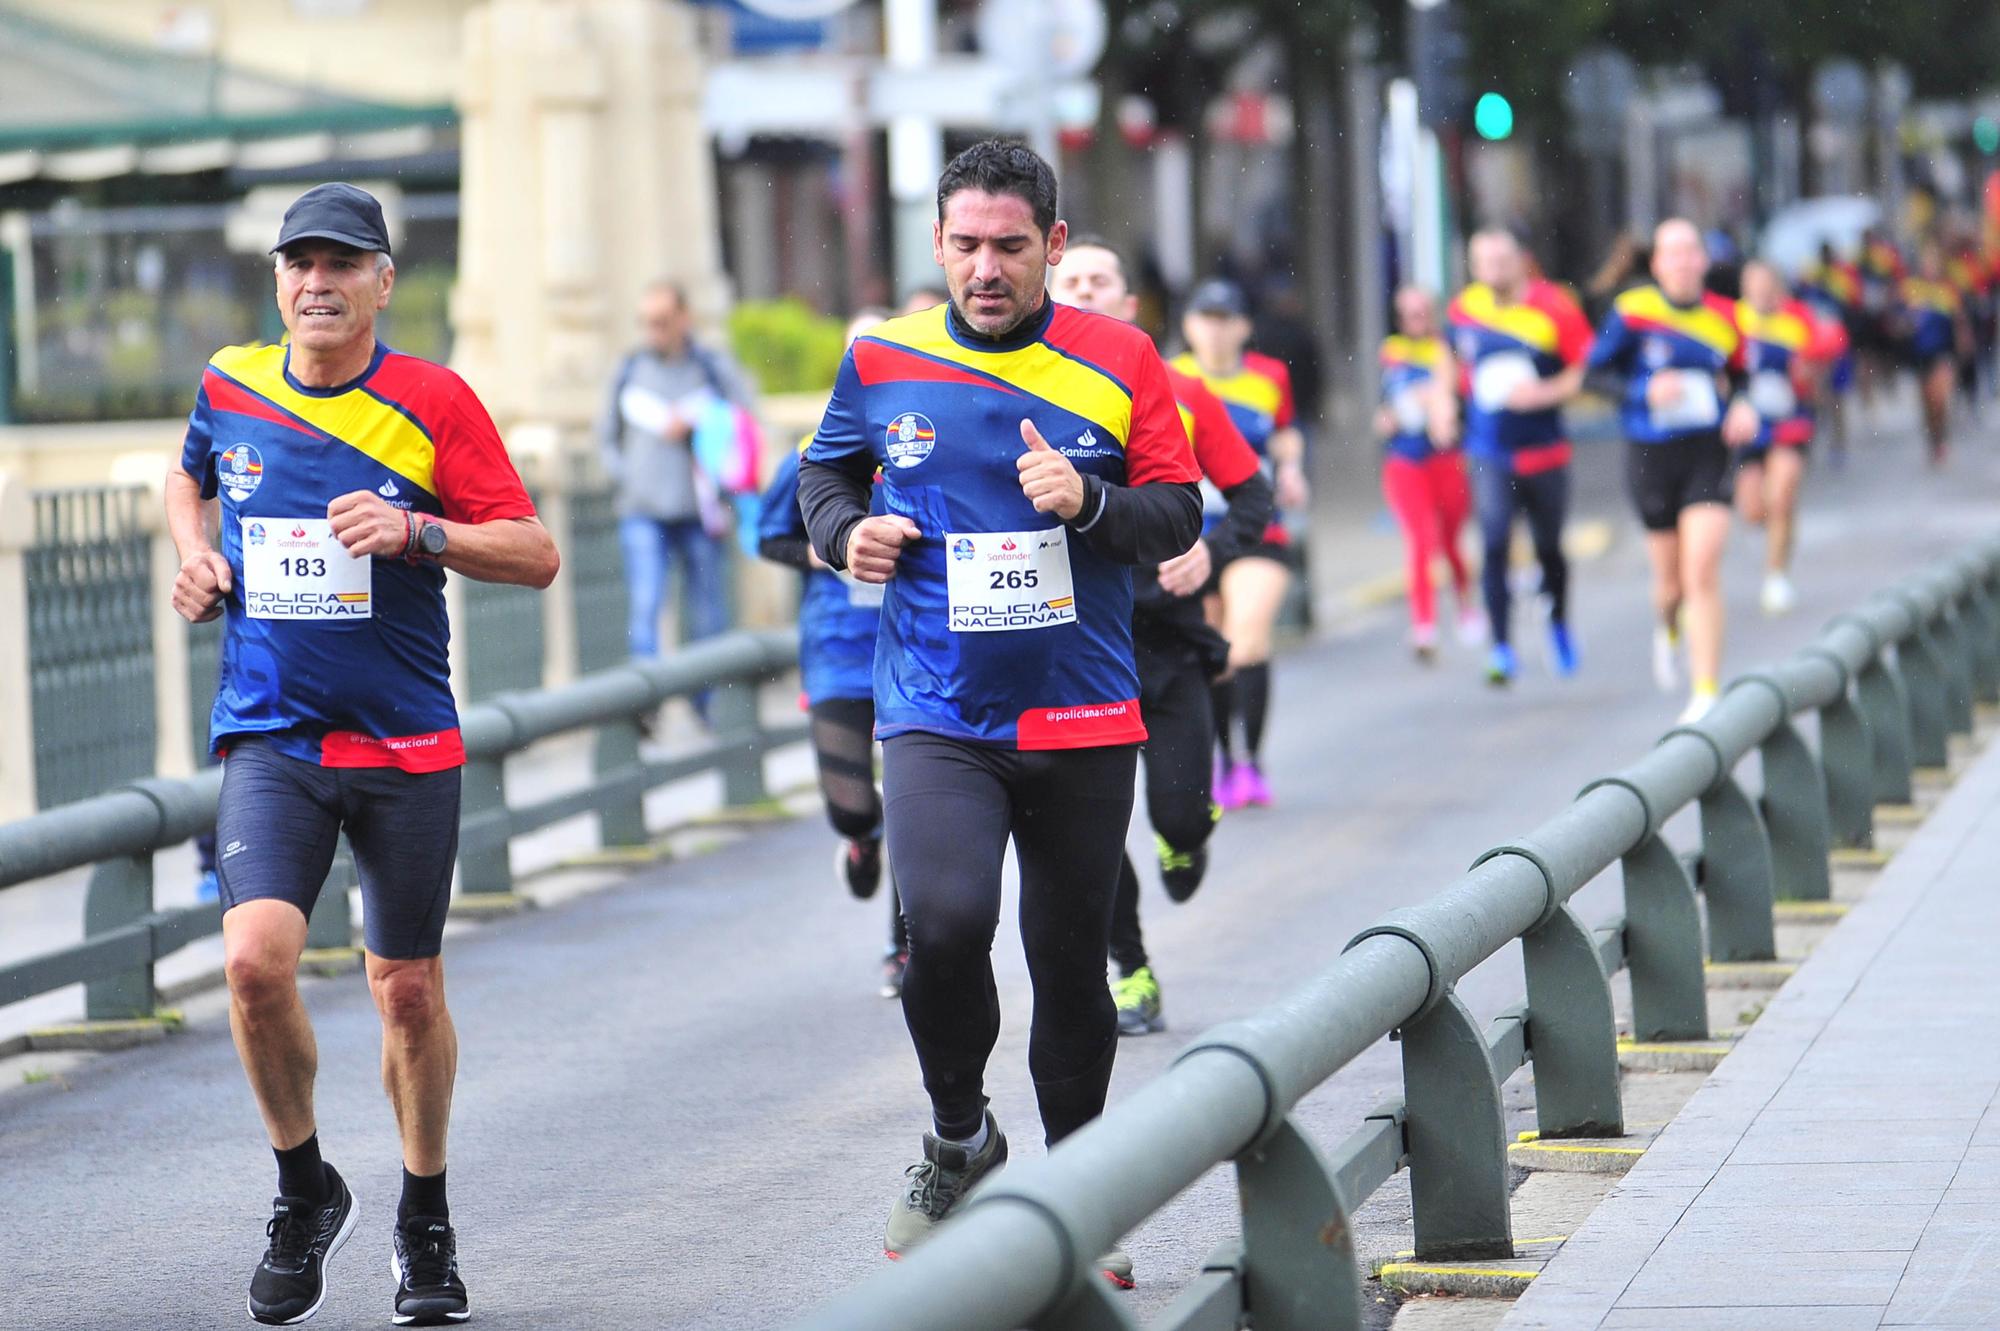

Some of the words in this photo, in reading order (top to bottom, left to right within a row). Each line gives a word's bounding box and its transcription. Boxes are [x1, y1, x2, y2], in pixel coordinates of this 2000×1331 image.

[277, 539, 319, 549] Santander
[987, 552, 1032, 561] Santander
[280, 558, 326, 577] 183
[989, 569, 1038, 589] 265
[248, 591, 340, 603] POLICIA
[249, 603, 369, 615] NACIONAL
[953, 601, 1051, 616] POLICIA
[953, 610, 1074, 627] NACIONAL
[1046, 704, 1127, 722] @policianacional
